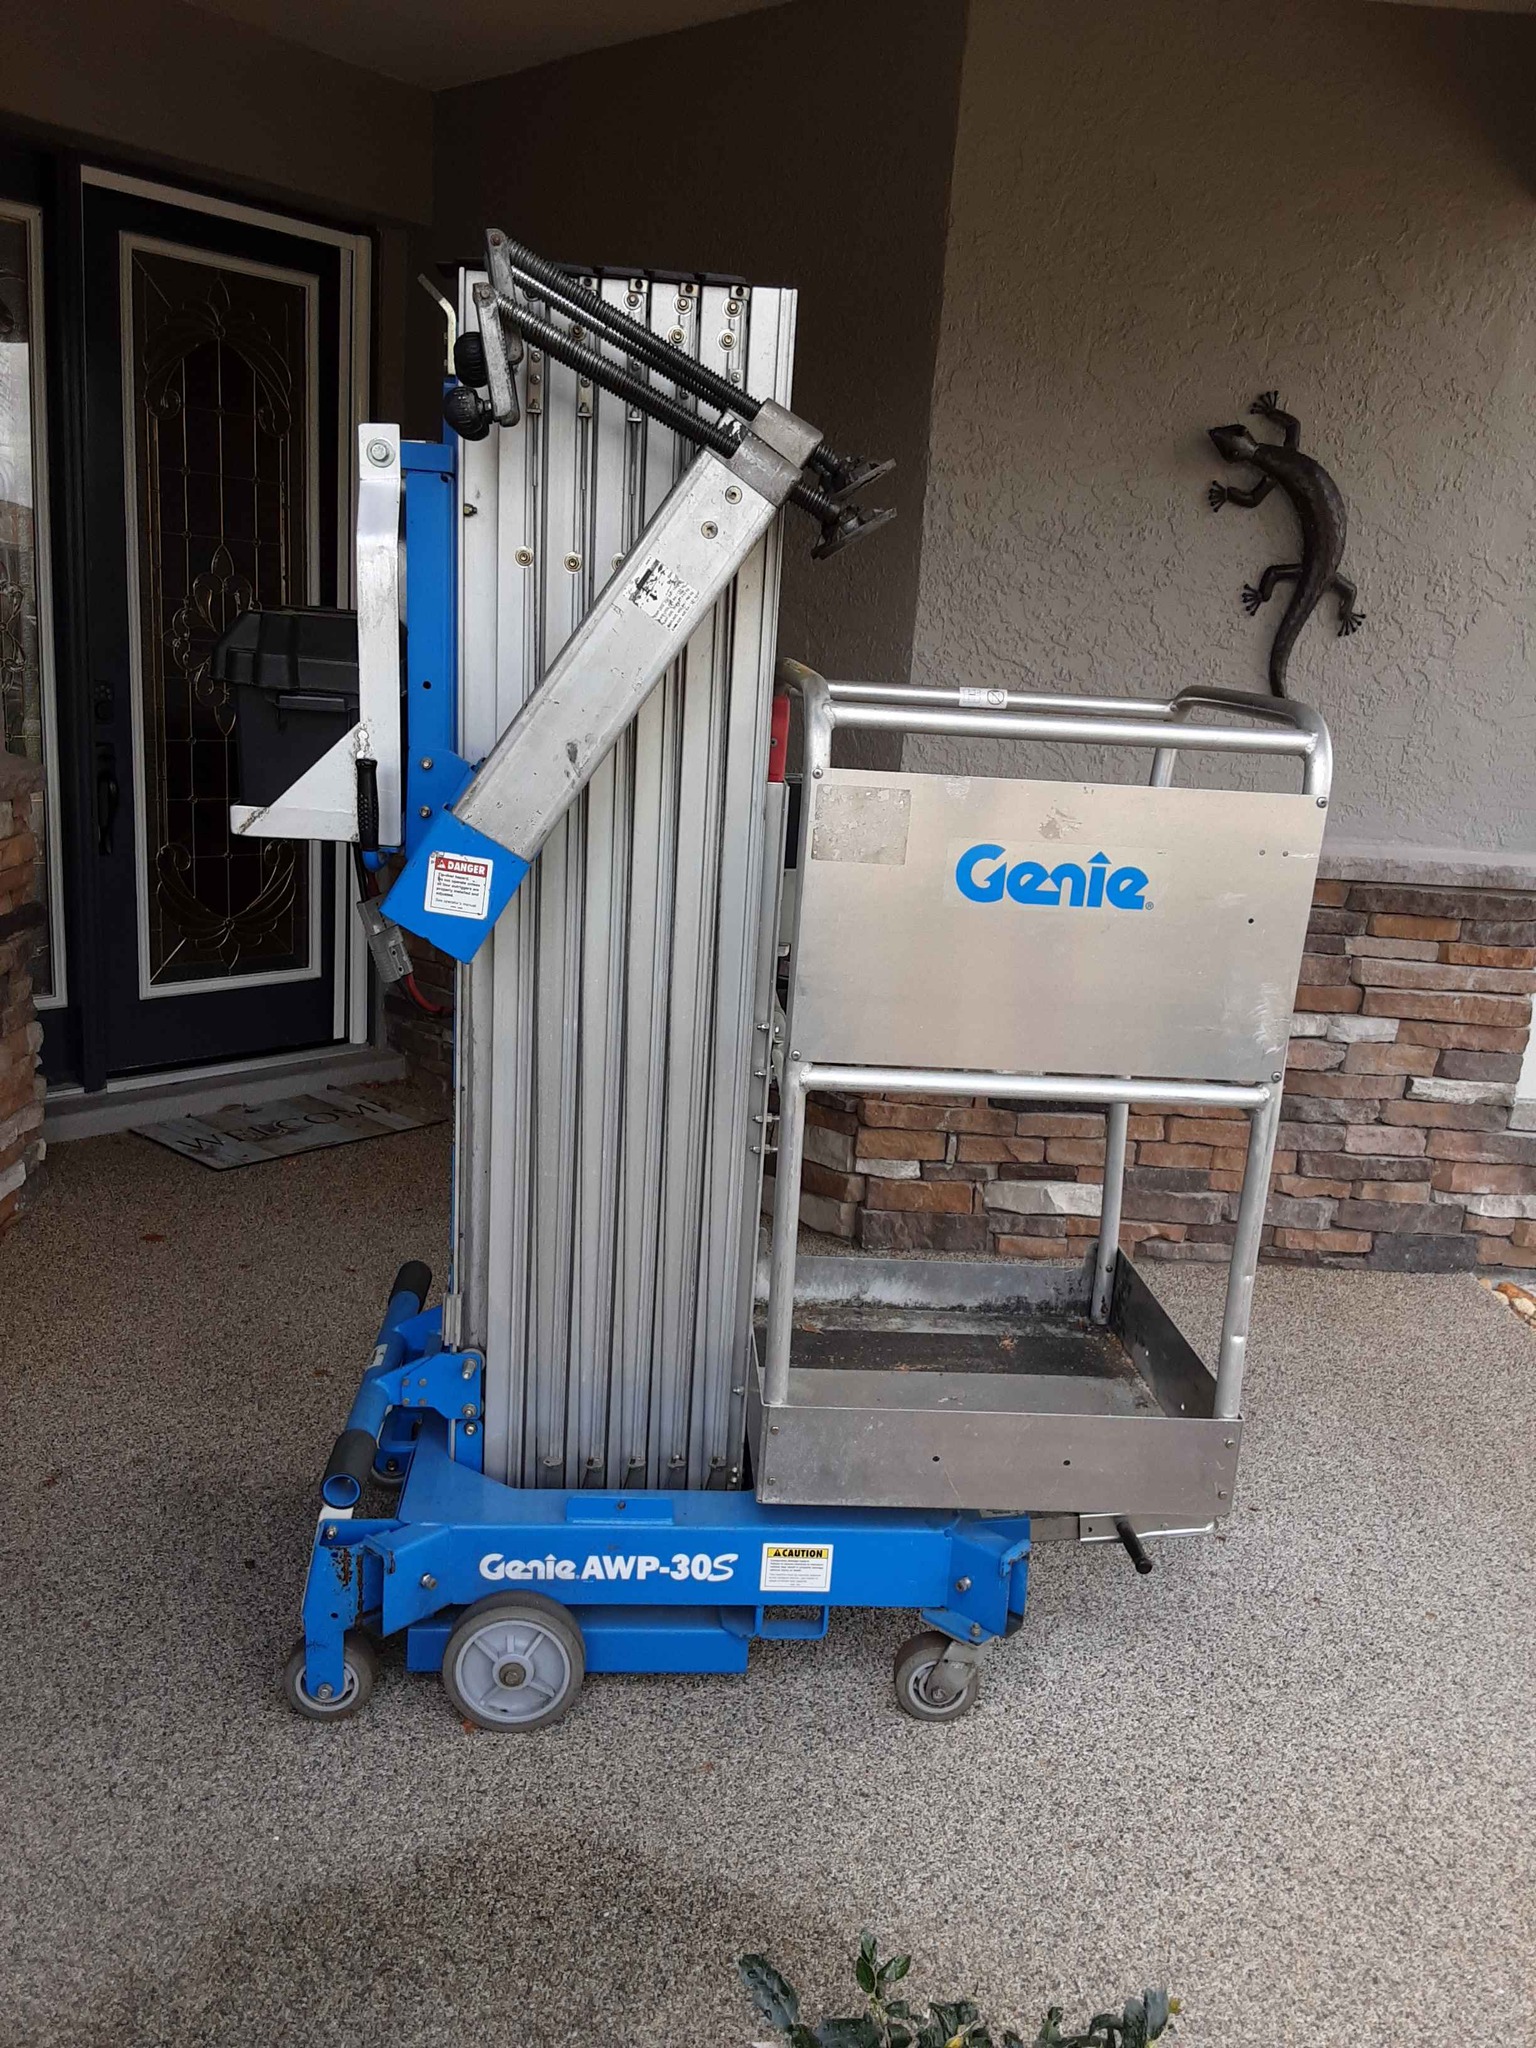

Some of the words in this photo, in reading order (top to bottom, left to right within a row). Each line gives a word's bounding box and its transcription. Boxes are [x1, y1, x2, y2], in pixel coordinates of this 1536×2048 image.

[447, 861, 486, 875] DANGER
[955, 843, 1150, 910] Genie
[782, 1549, 823, 1558] CAUTION
[479, 1553, 577, 1581] Genie
[580, 1553, 739, 1582] AWP-30S
